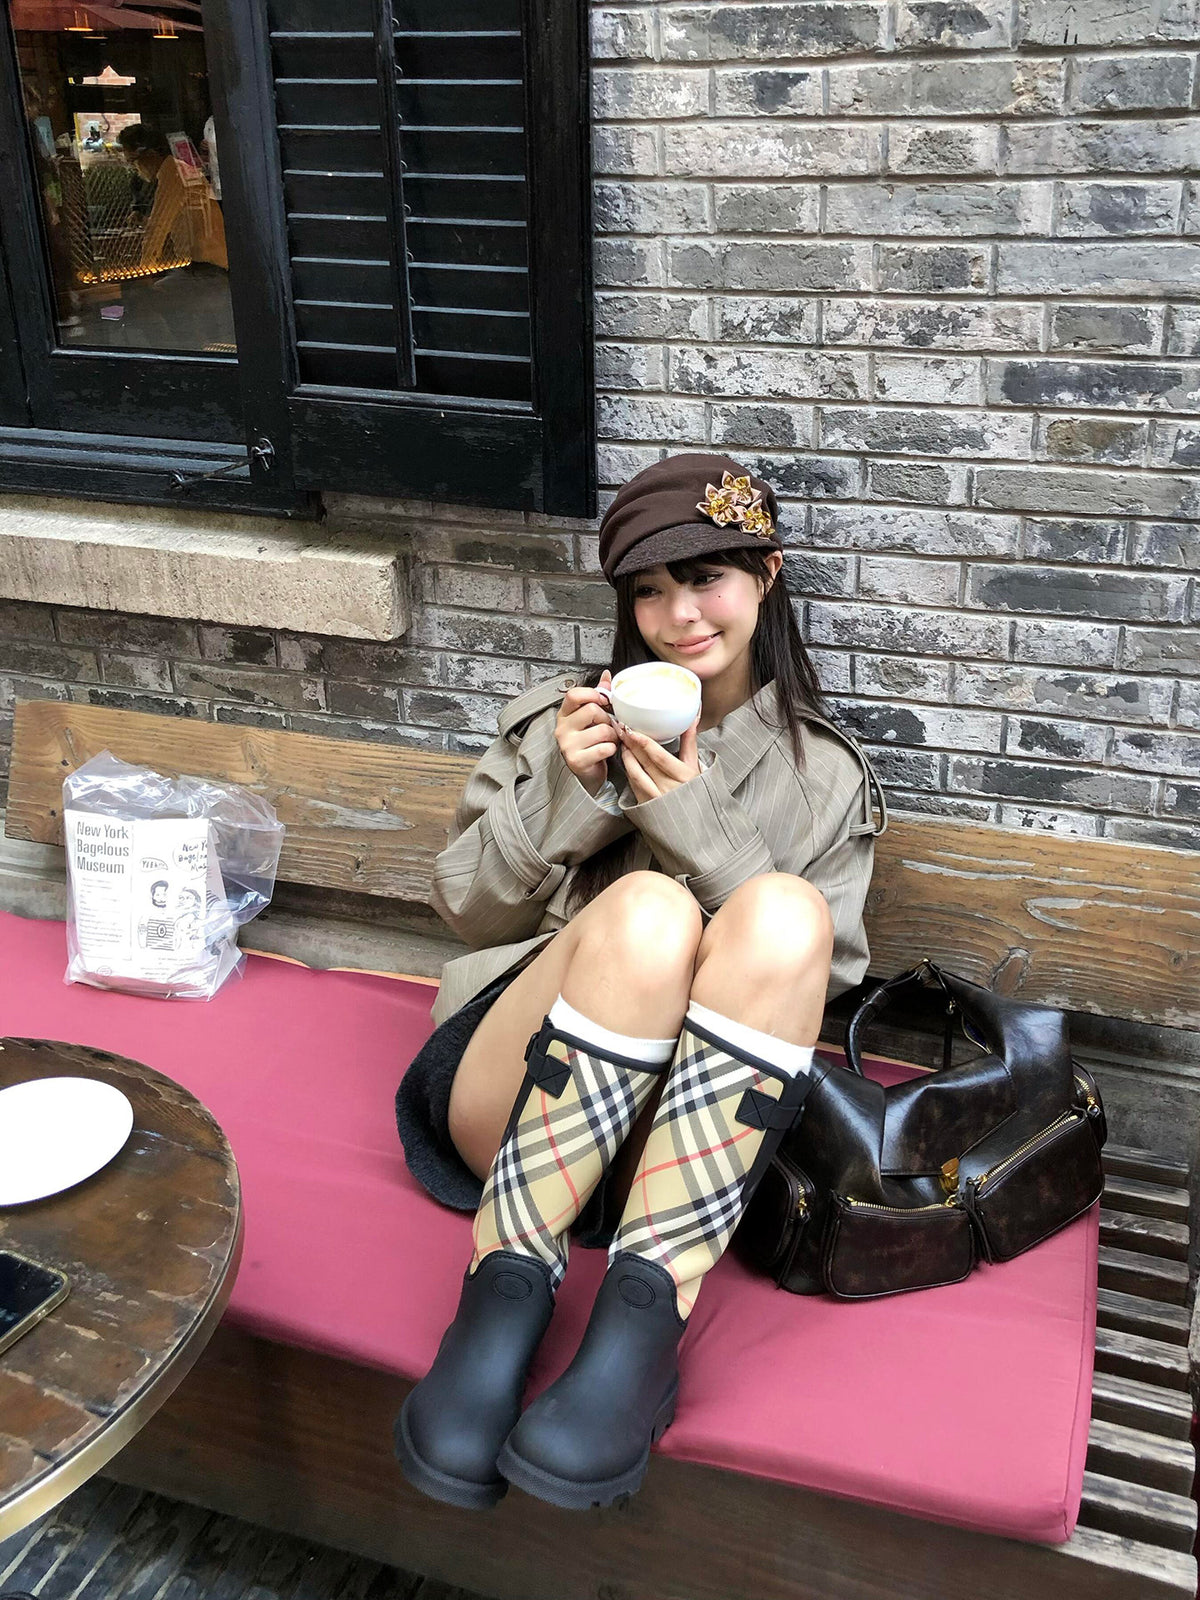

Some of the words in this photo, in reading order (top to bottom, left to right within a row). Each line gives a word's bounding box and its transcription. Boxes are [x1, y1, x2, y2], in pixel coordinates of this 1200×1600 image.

[77, 821, 101, 837] New
[104, 824, 129, 839] York
[77, 839, 129, 857] Bagelous
[77, 856, 125, 874] Museum
